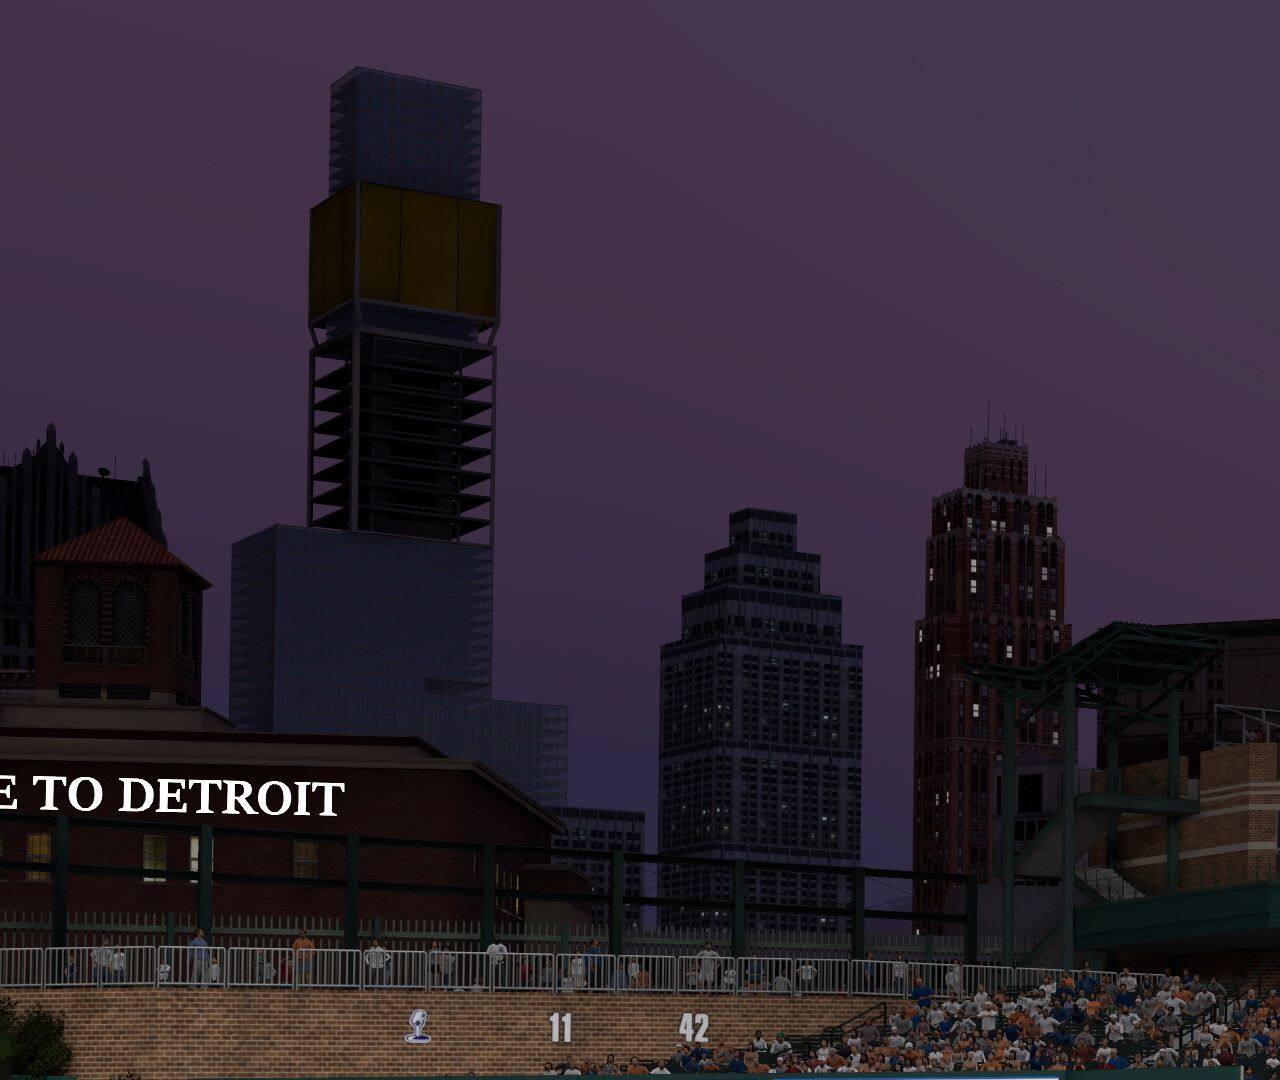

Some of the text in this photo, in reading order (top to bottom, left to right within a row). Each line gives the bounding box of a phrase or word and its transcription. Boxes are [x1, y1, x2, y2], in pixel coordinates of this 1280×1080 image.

[33, 776, 103, 812] TO
[119, 777, 345, 817] DETROIT
[550, 1012, 572, 1043] 11
[679, 1013, 710, 1043] 42
